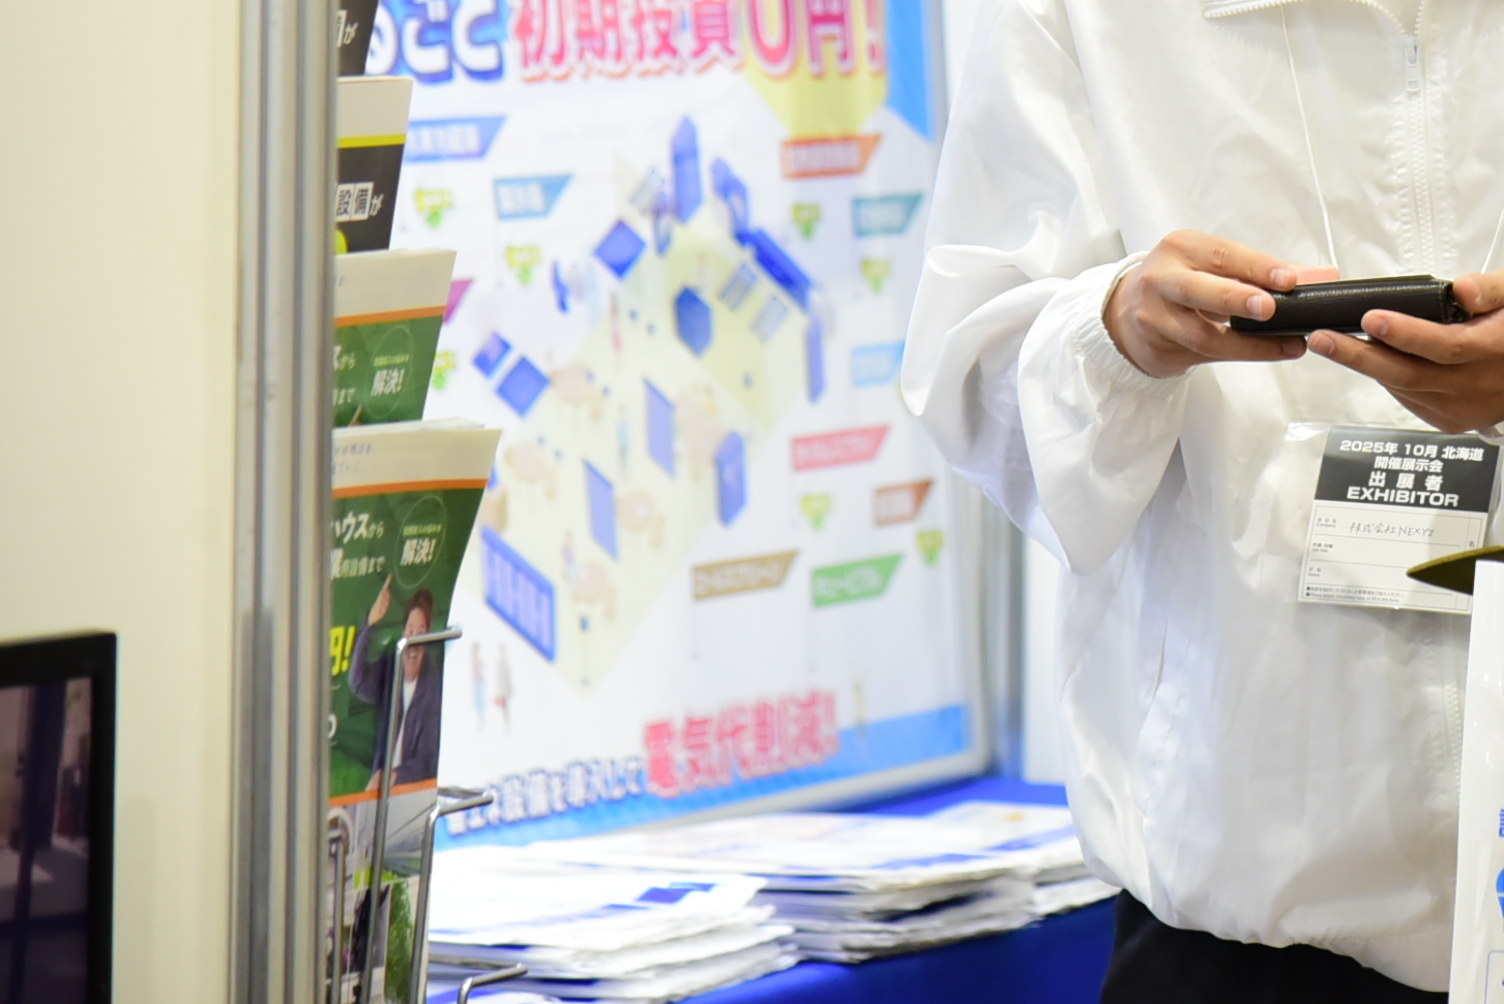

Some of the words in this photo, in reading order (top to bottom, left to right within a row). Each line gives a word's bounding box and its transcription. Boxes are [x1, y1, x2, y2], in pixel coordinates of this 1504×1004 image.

[370, 367, 406, 397] 解決!
[1339, 439, 1399, 455] 2025年
[1403, 443, 1438, 459] 10月
[1441, 445, 1485, 462] 北海道
[1373, 456, 1444, 474] 開催展示会
[1346, 486, 1460, 507] EXHIBITOR
[401, 539, 437, 567] 解決!
